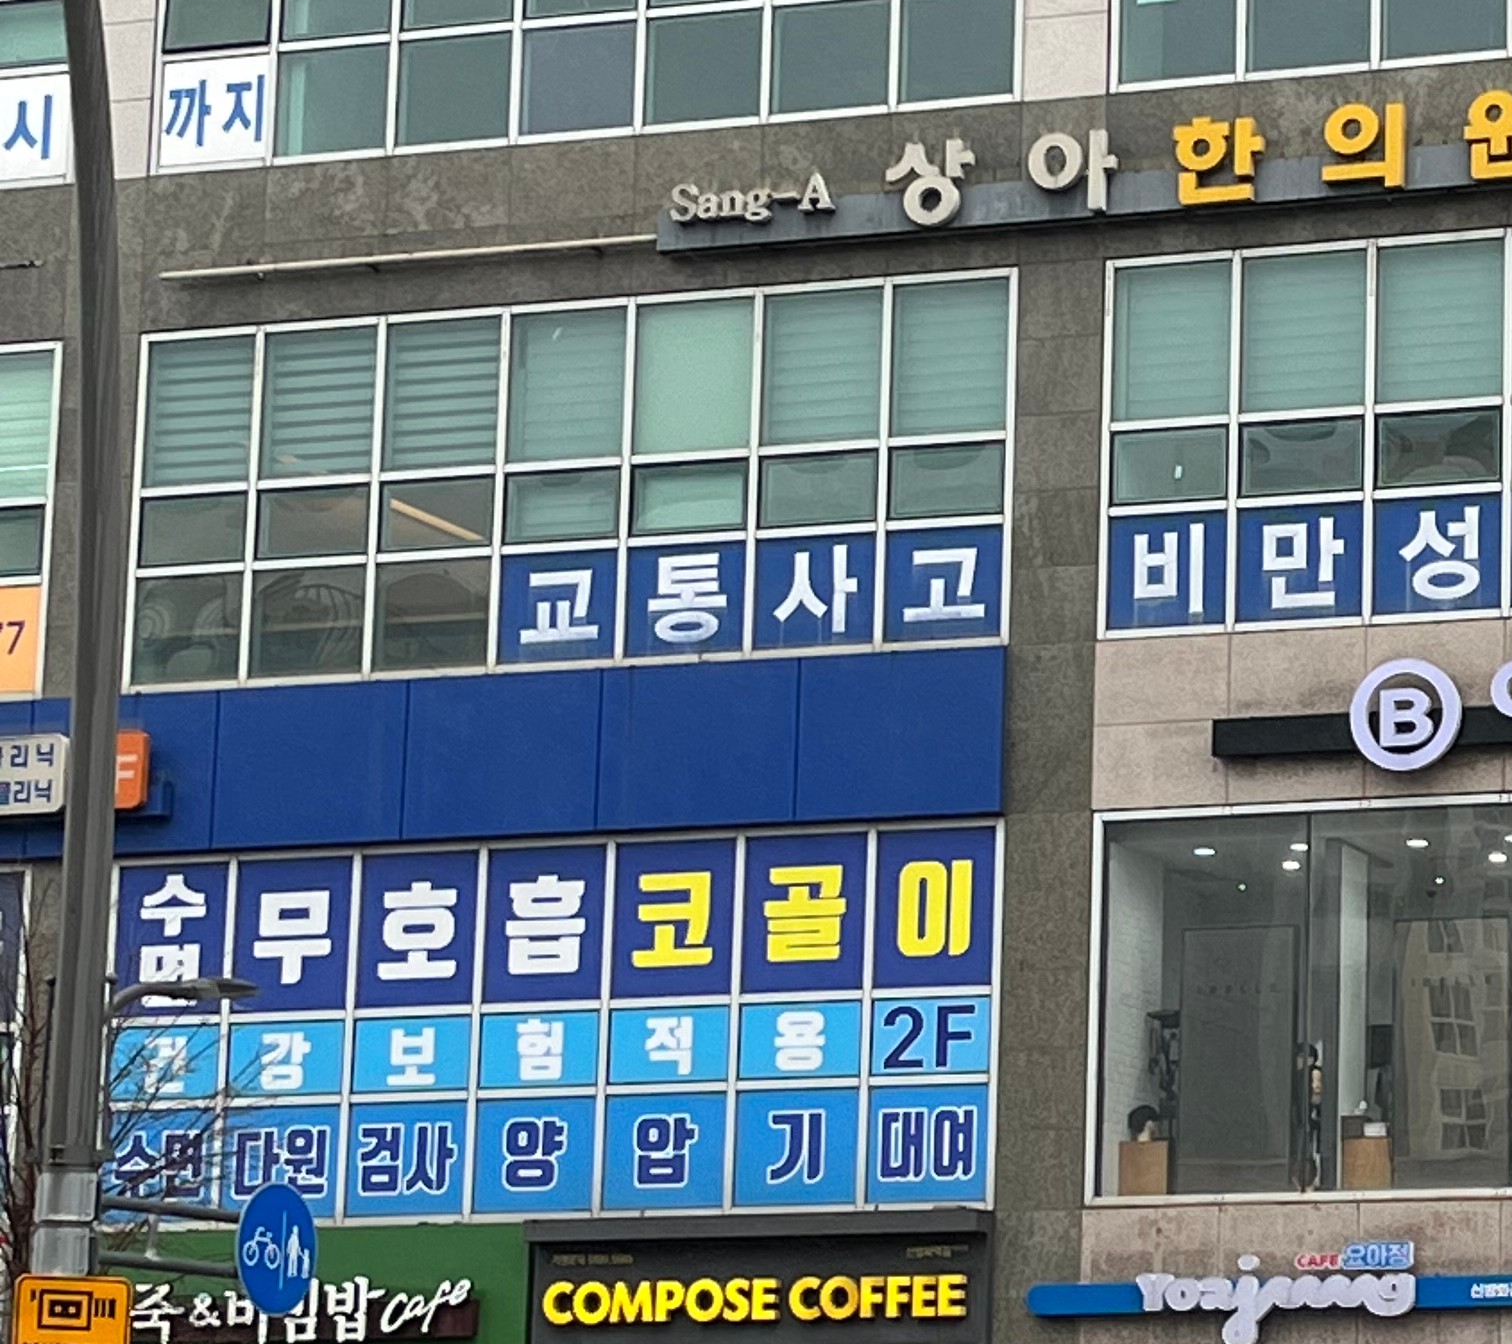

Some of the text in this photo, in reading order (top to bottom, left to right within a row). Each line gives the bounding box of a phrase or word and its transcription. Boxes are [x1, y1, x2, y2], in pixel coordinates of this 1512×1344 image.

[164, 74, 266, 148] 까지
[668, 172, 838, 228] Sang-A
[518, 542, 987, 645] 교통사고
[0, 742, 55, 769] 리닉
[630, 857, 976, 971] 코골이
[881, 1002, 977, 1071] 2F
[1297, 1243, 1412, 1269] CAFE 요아정
[542, 1273, 969, 1326] COMPOSE COFFEE
